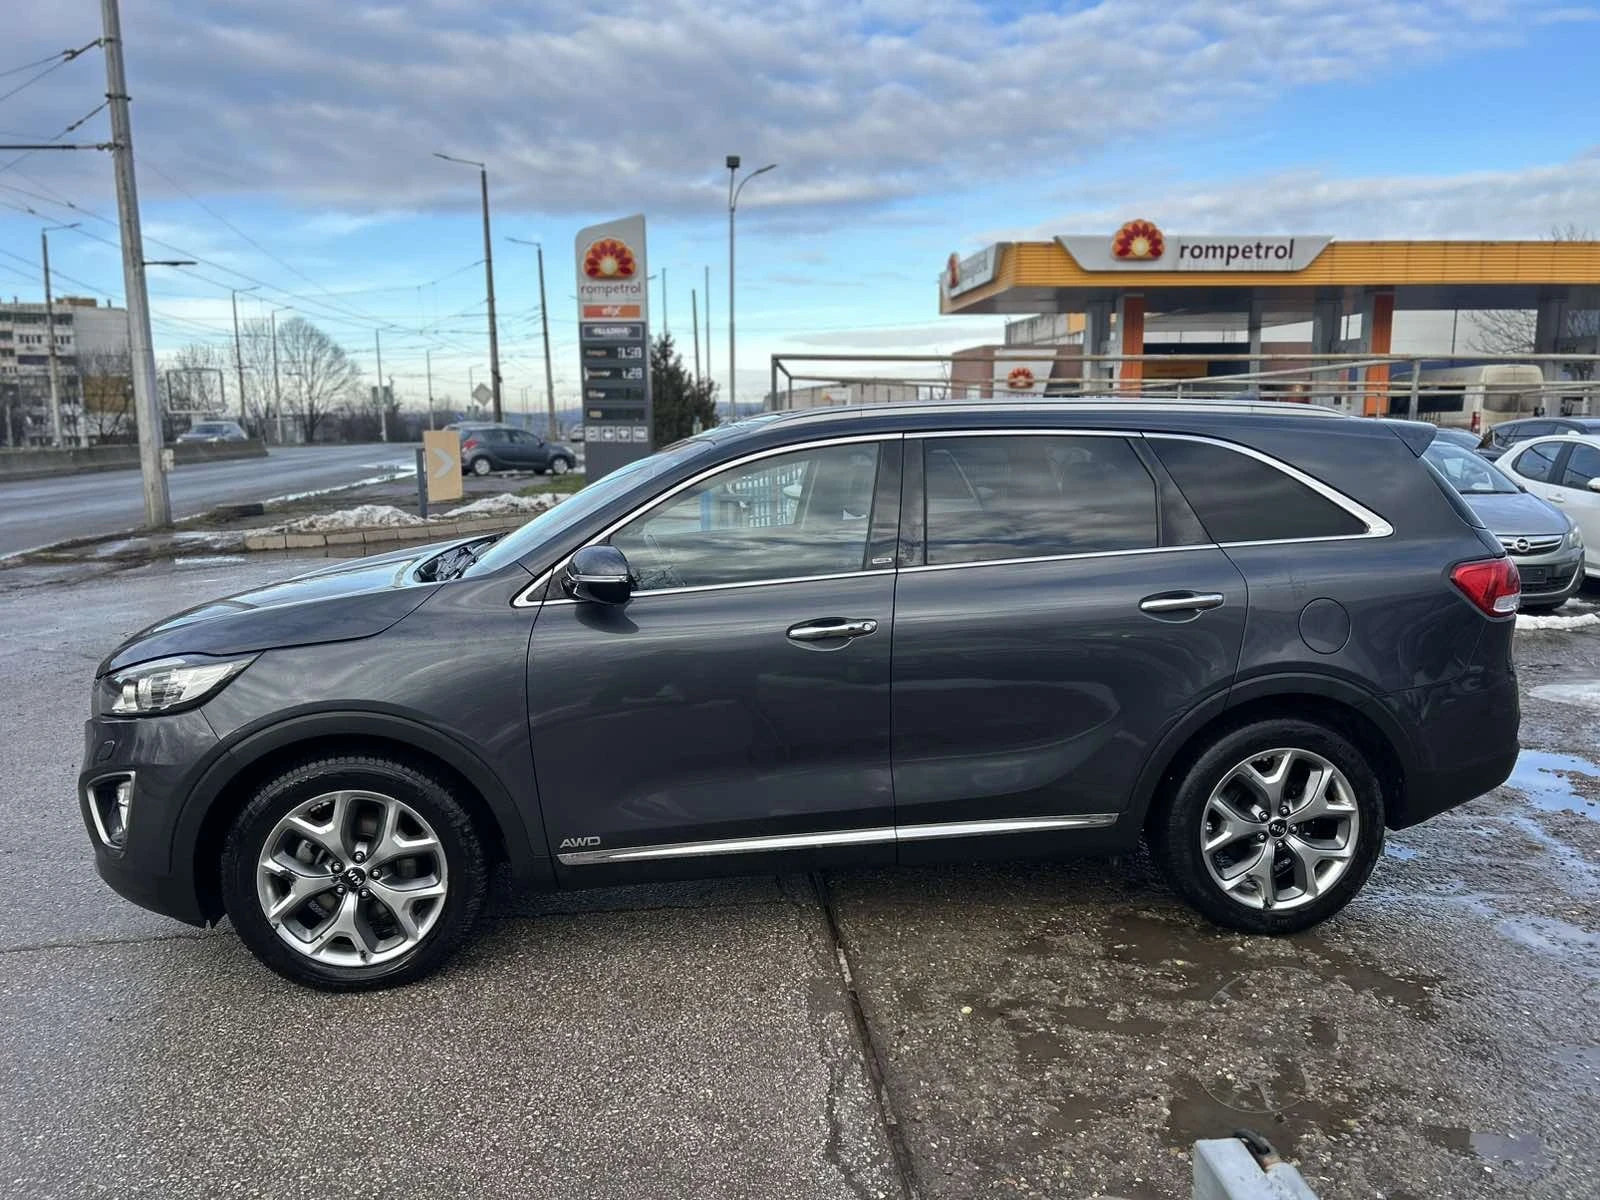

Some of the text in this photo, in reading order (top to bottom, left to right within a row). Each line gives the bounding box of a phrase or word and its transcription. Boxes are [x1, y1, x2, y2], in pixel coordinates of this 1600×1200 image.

[1180, 238, 1294, 266] rompetrol
[581, 282, 641, 296] rompetrol
[1271, 823, 1285, 834] KIA
[560, 836, 601, 848] AWD
[348, 870, 363, 886] KIA
